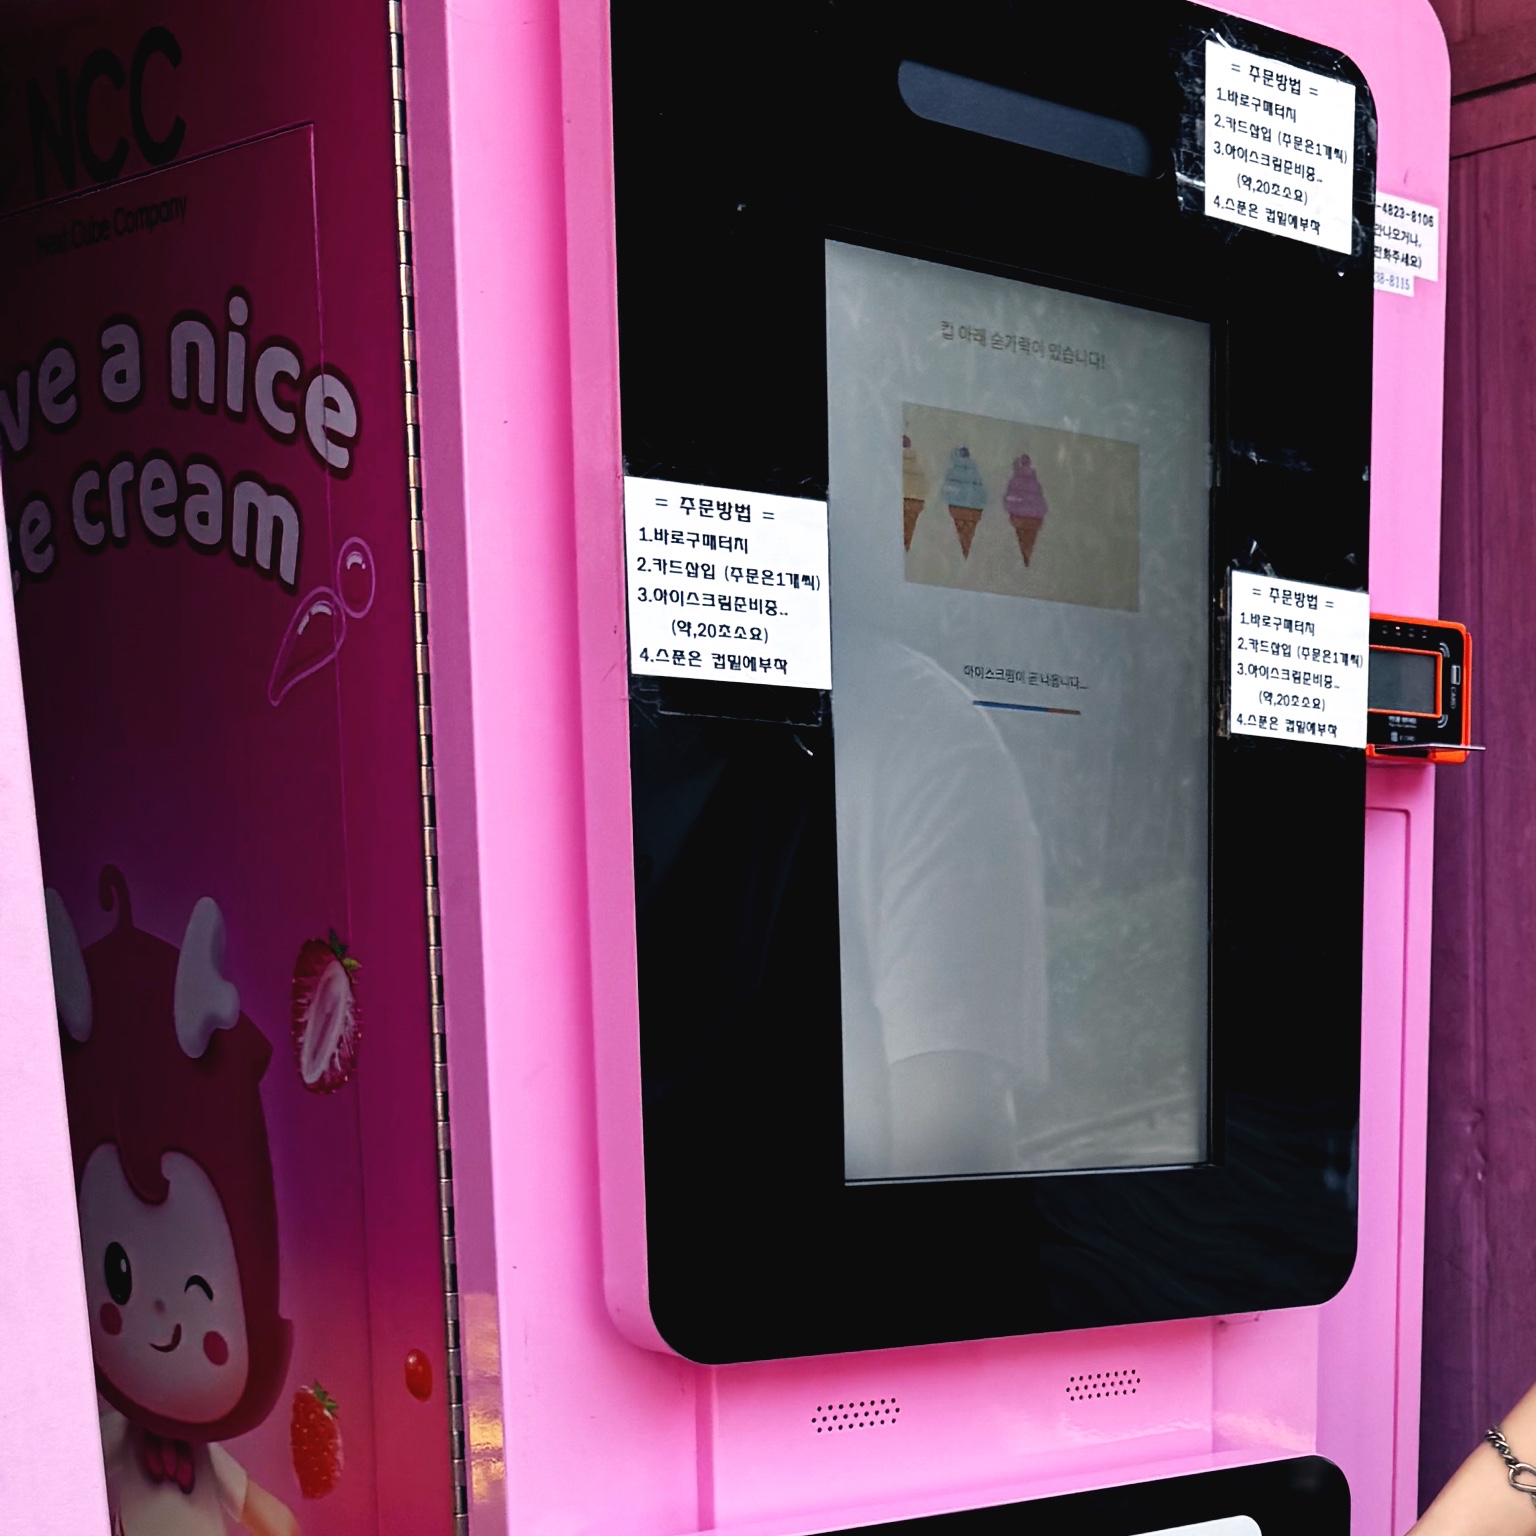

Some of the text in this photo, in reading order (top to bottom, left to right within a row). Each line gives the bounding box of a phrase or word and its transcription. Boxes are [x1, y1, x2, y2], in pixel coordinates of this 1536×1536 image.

[1249, 64, 1301, 96] 주문방법
[27, 26, 186, 200] NCC
[113, 194, 187, 236] Company
[102, 324, 141, 402] a
[170, 296, 357, 469] nice
[72, 458, 299, 585] cream
[680, 497, 751, 522] 주문방법
[637, 557, 716, 580] 2.카드삽입
[1269, 587, 1318, 610] 주문방법
[639, 647, 703, 668] 4.스푼은
